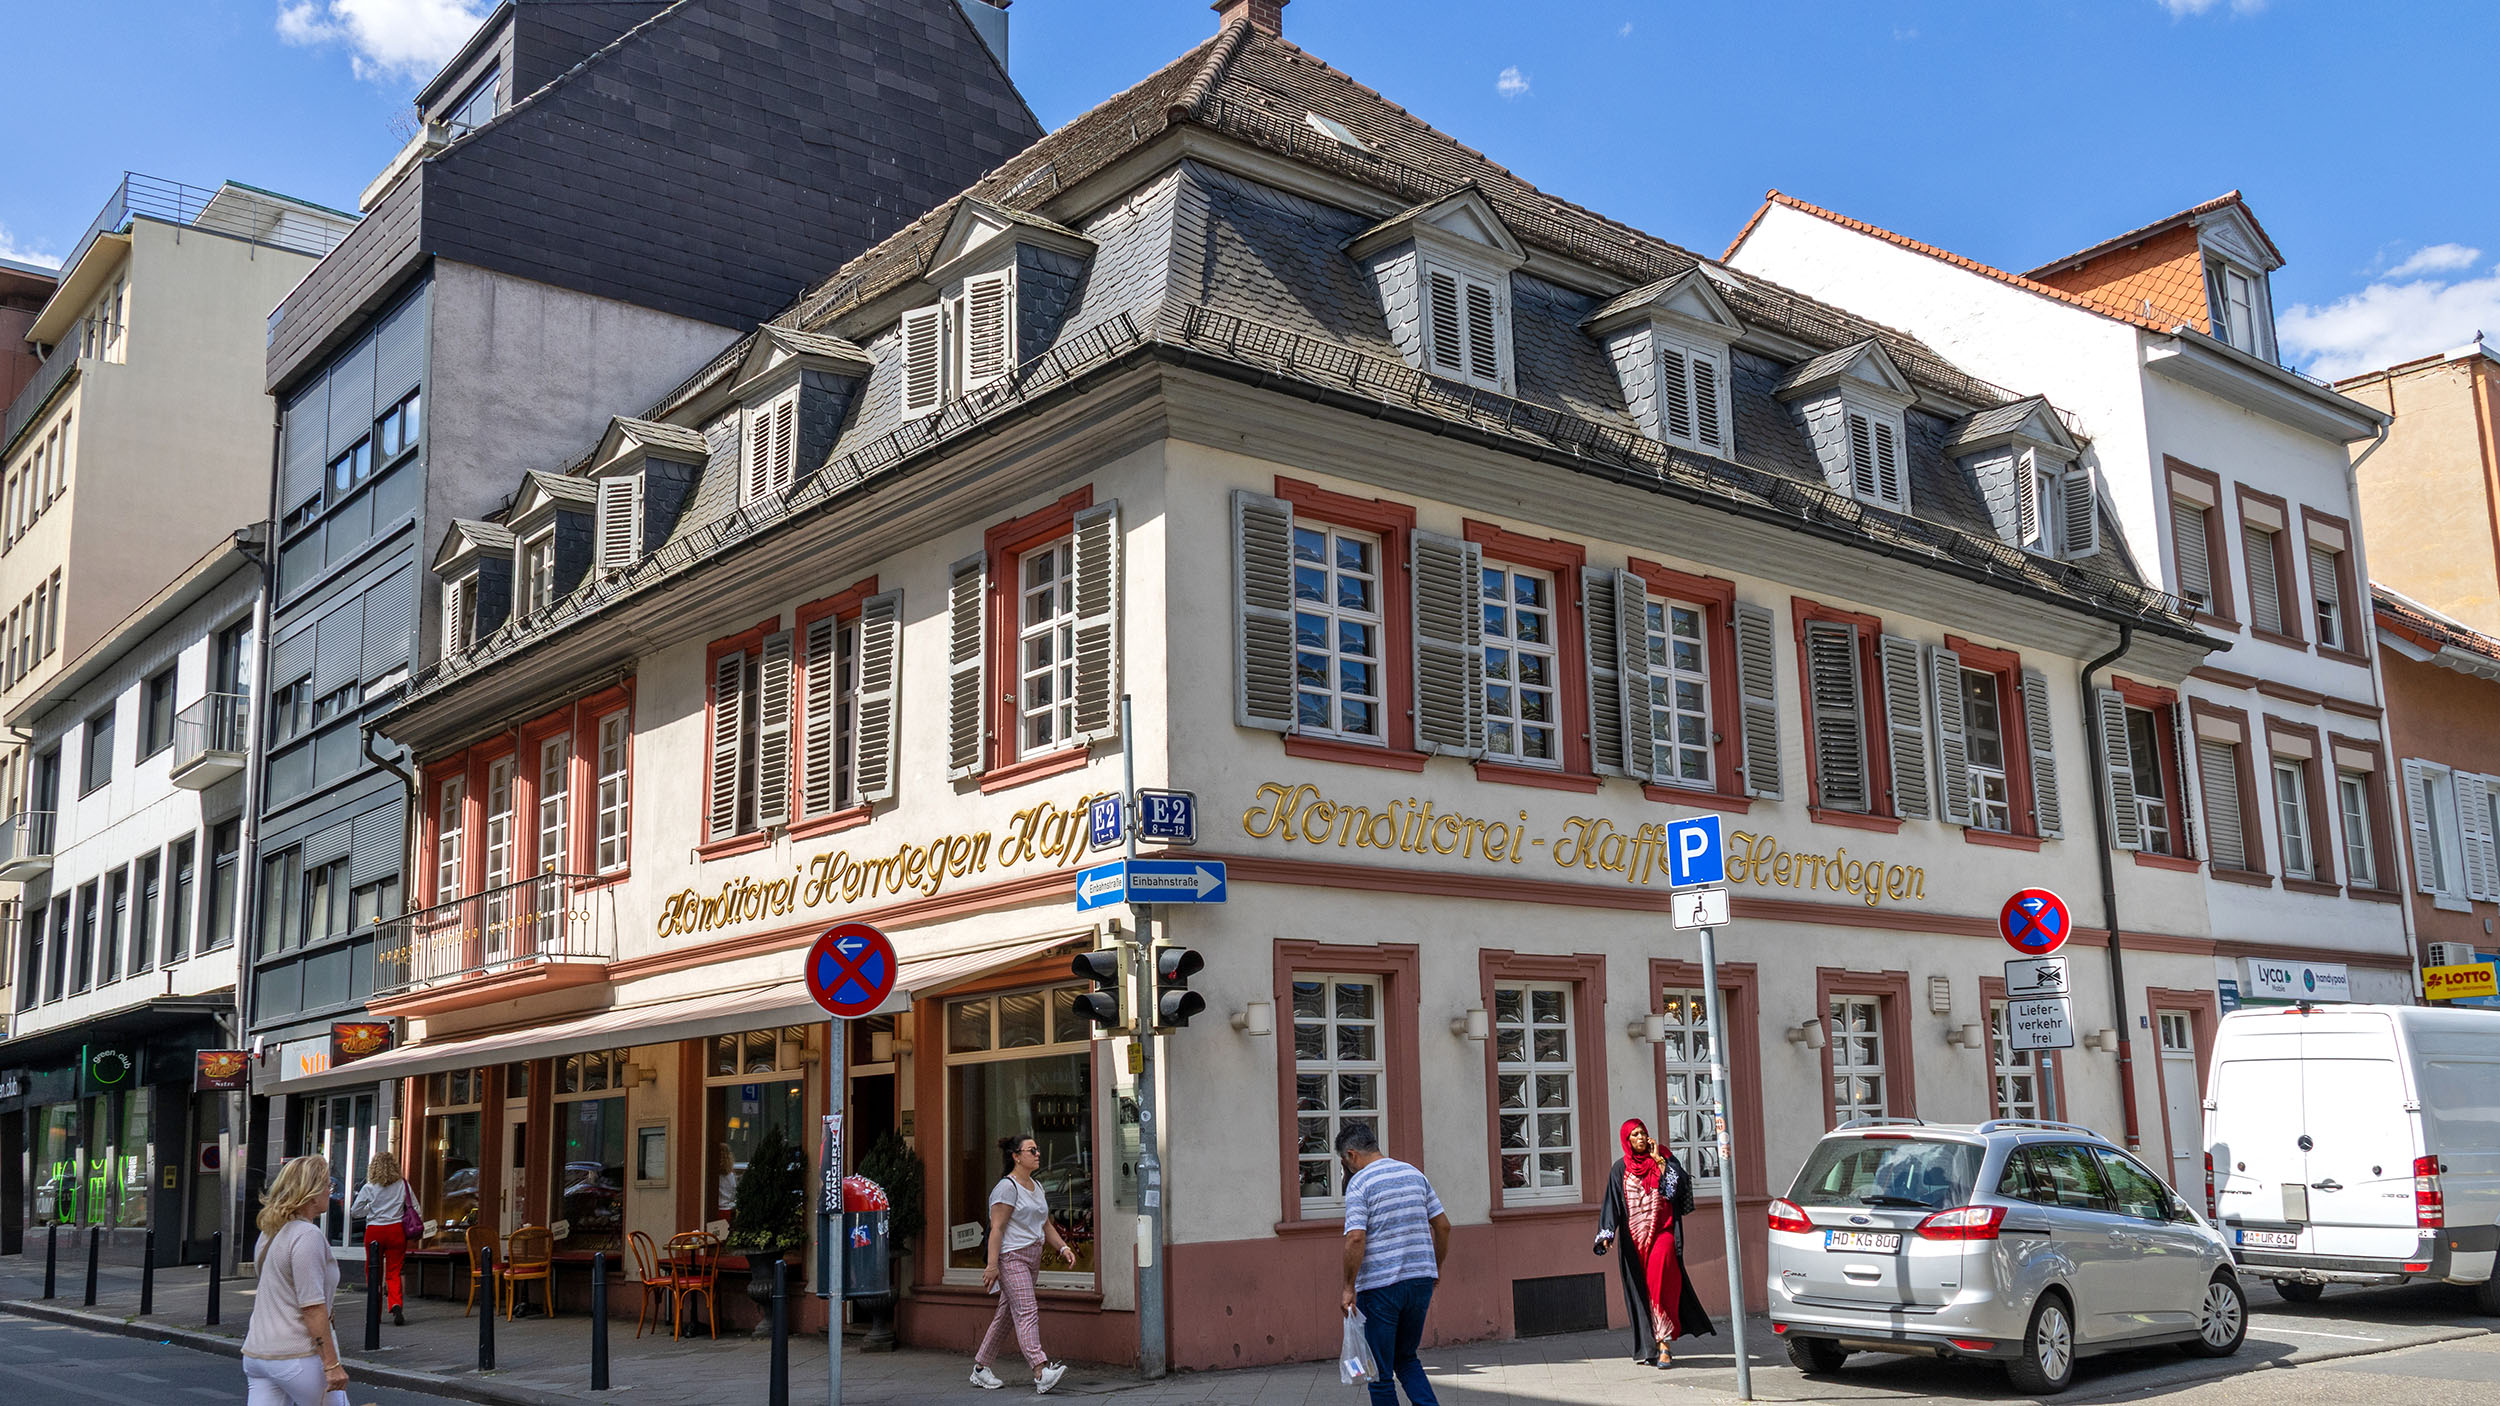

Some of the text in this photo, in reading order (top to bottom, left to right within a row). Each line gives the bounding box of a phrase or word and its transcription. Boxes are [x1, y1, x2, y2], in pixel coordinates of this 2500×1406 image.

[1174, 826, 1184, 835] 12
[1243, 782, 1528, 864] Konditorei
[1725, 830, 1925, 907] Herrdegen
[1679, 827, 1709, 878] P
[657, 863, 802, 938] Konditorei
[803, 830, 992, 908] Herrdegen
[1089, 877, 1123, 894] Einbahnstraße
[1131, 876, 1199, 888] Einbahnstraße
[2258, 964, 2285, 985] Lyca
[2445, 970, 2491, 985] LOTTO
[2019, 1004, 2059, 1016] Liefer-
[2018, 1018, 2063, 1030] verkehr
[2032, 1032, 2052, 1044] frei
[1833, 1232, 1900, 1249] HD KG 800
[2242, 1232, 2295, 1245] MA UR 614
